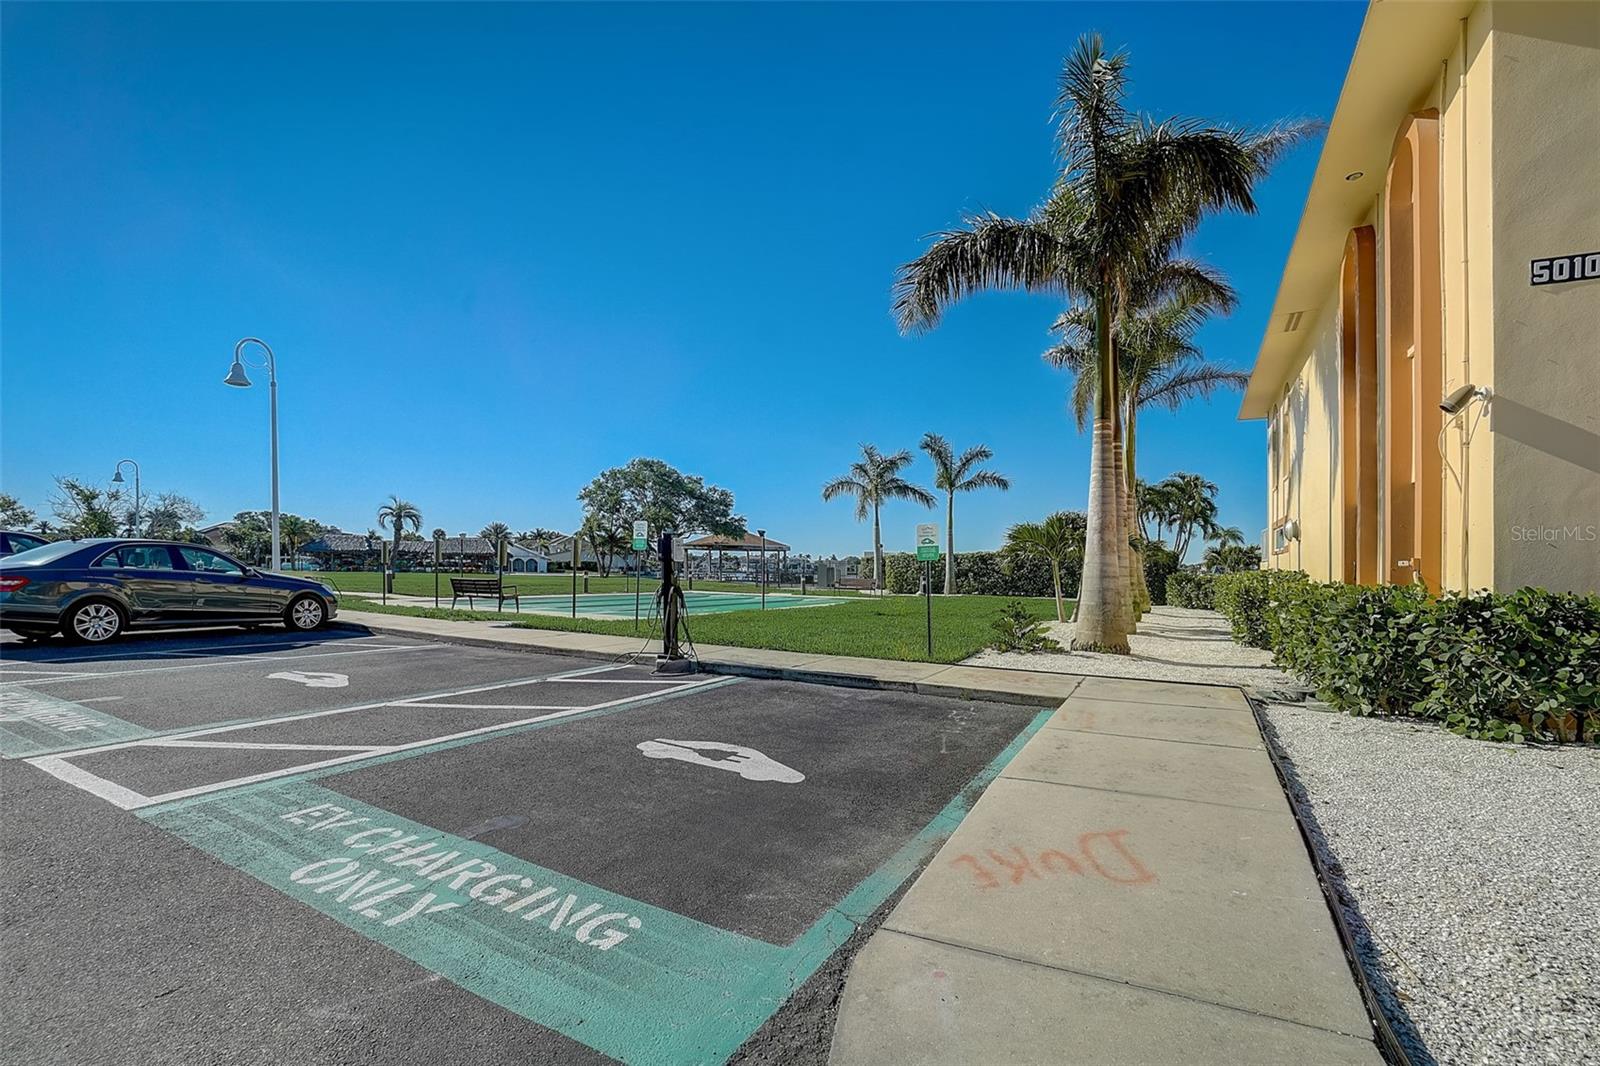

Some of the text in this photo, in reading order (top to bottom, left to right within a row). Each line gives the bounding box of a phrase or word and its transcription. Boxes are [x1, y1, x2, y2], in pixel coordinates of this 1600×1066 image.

[1532, 254, 1600, 284] 5010
[279, 802, 642, 951] EV CHARGING
[290, 857, 459, 927] ONLY
